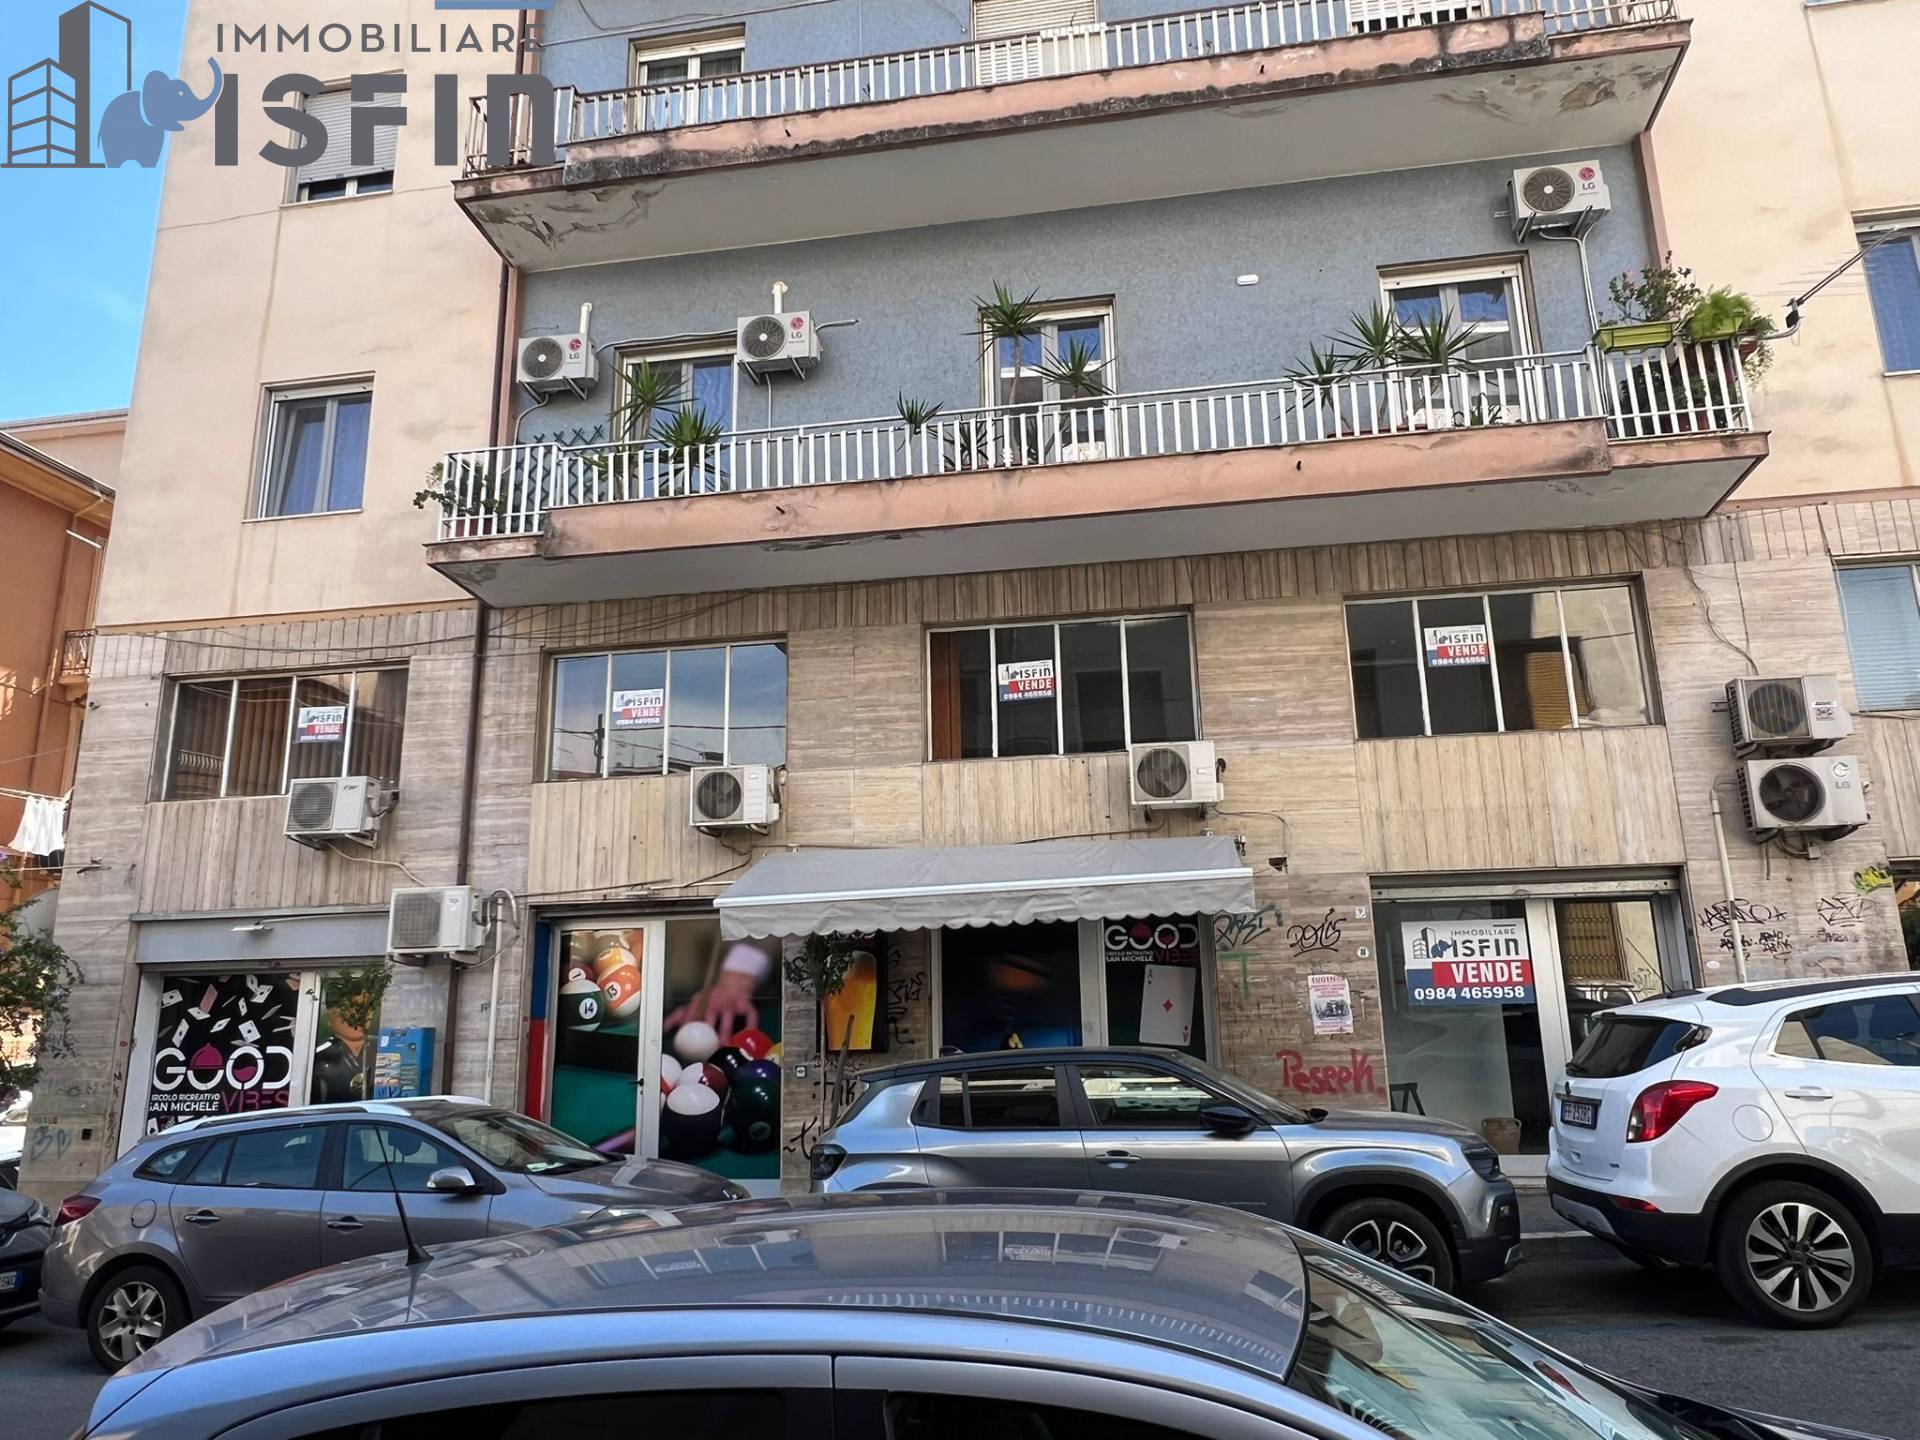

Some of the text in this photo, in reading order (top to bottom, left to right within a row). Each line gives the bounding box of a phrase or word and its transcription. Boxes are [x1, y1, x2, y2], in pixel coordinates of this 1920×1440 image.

[1582, 182, 1596, 190] LG
[791, 331, 802, 339] LG
[1447, 644, 1486, 657] VENDE
[1018, 679, 1052, 691] VENDE
[632, 707, 662, 718] VENDE
[314, 724, 341, 734] VENDE
[1104, 921, 1199, 951] GOOD
[1451, 928, 1516, 937] IMMOBILIARE
[1450, 962, 1524, 984] VENDE
[1414, 985, 1526, 1001] 0984 465958
[584, 1002, 594, 1015] 14
[152, 1042, 294, 1092] GOOD
[170, 1101, 220, 1112] MICHELE
[221, 1089, 289, 1113] VIBES
